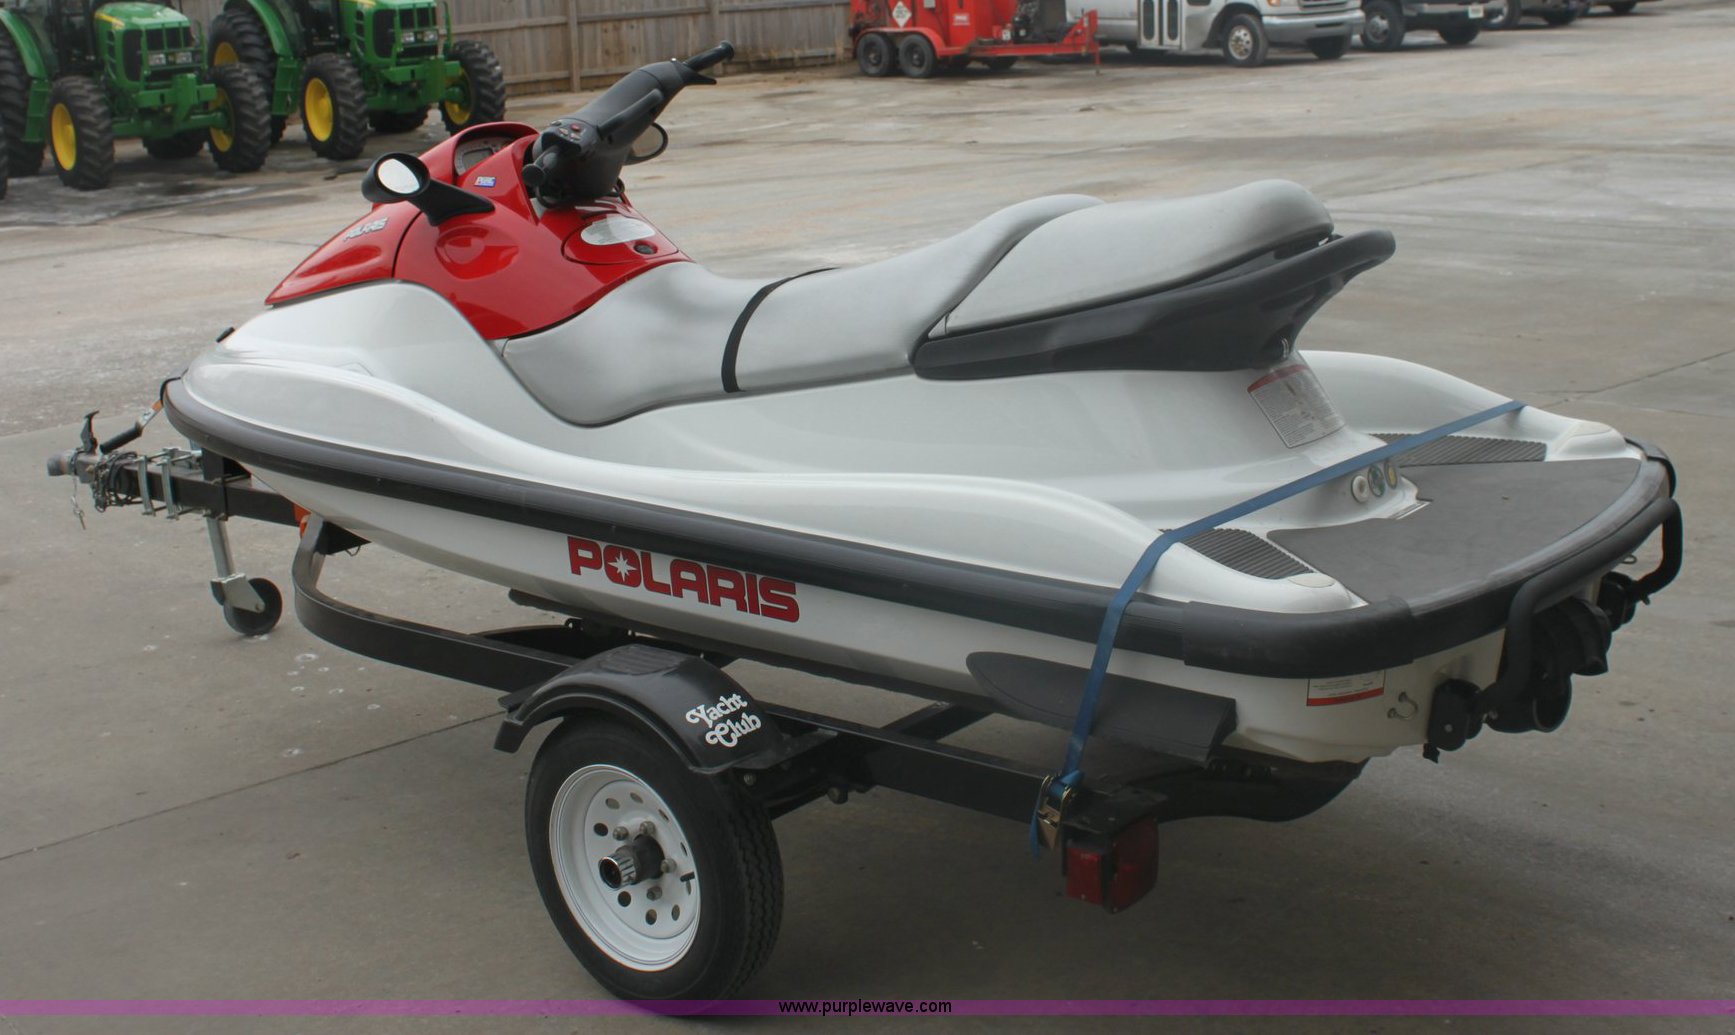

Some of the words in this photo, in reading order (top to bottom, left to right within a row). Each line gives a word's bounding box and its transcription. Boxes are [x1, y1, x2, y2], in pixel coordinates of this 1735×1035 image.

[568, 536, 800, 623] POLARIS
[685, 693, 748, 728] Yacht
[705, 712, 761, 748] Club
